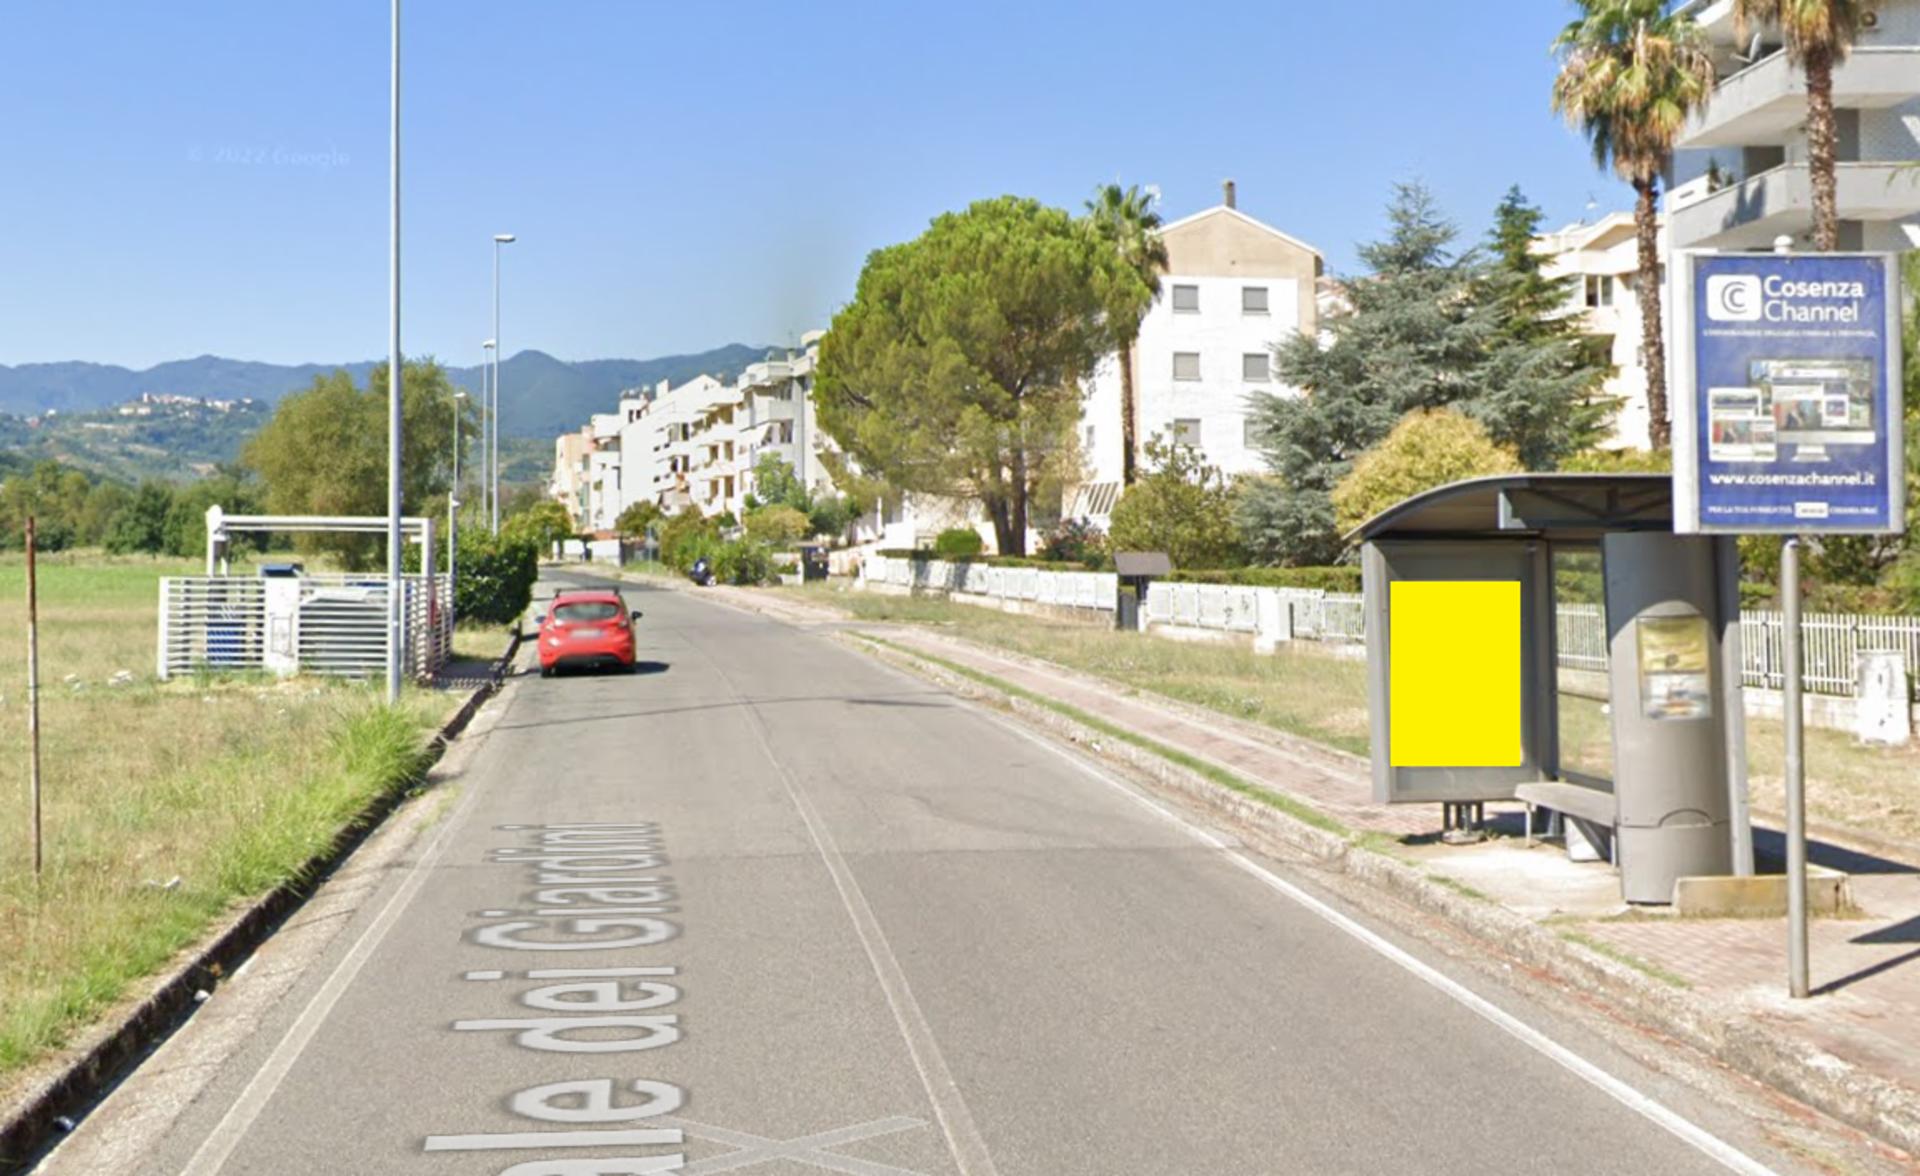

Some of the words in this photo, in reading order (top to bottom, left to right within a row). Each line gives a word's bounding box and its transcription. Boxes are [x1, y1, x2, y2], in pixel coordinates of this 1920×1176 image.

[1764, 275, 1864, 298] Cosenza
[1764, 300, 1858, 322] Channel
[1709, 472, 1875, 486] www.cosenzachannel.it
